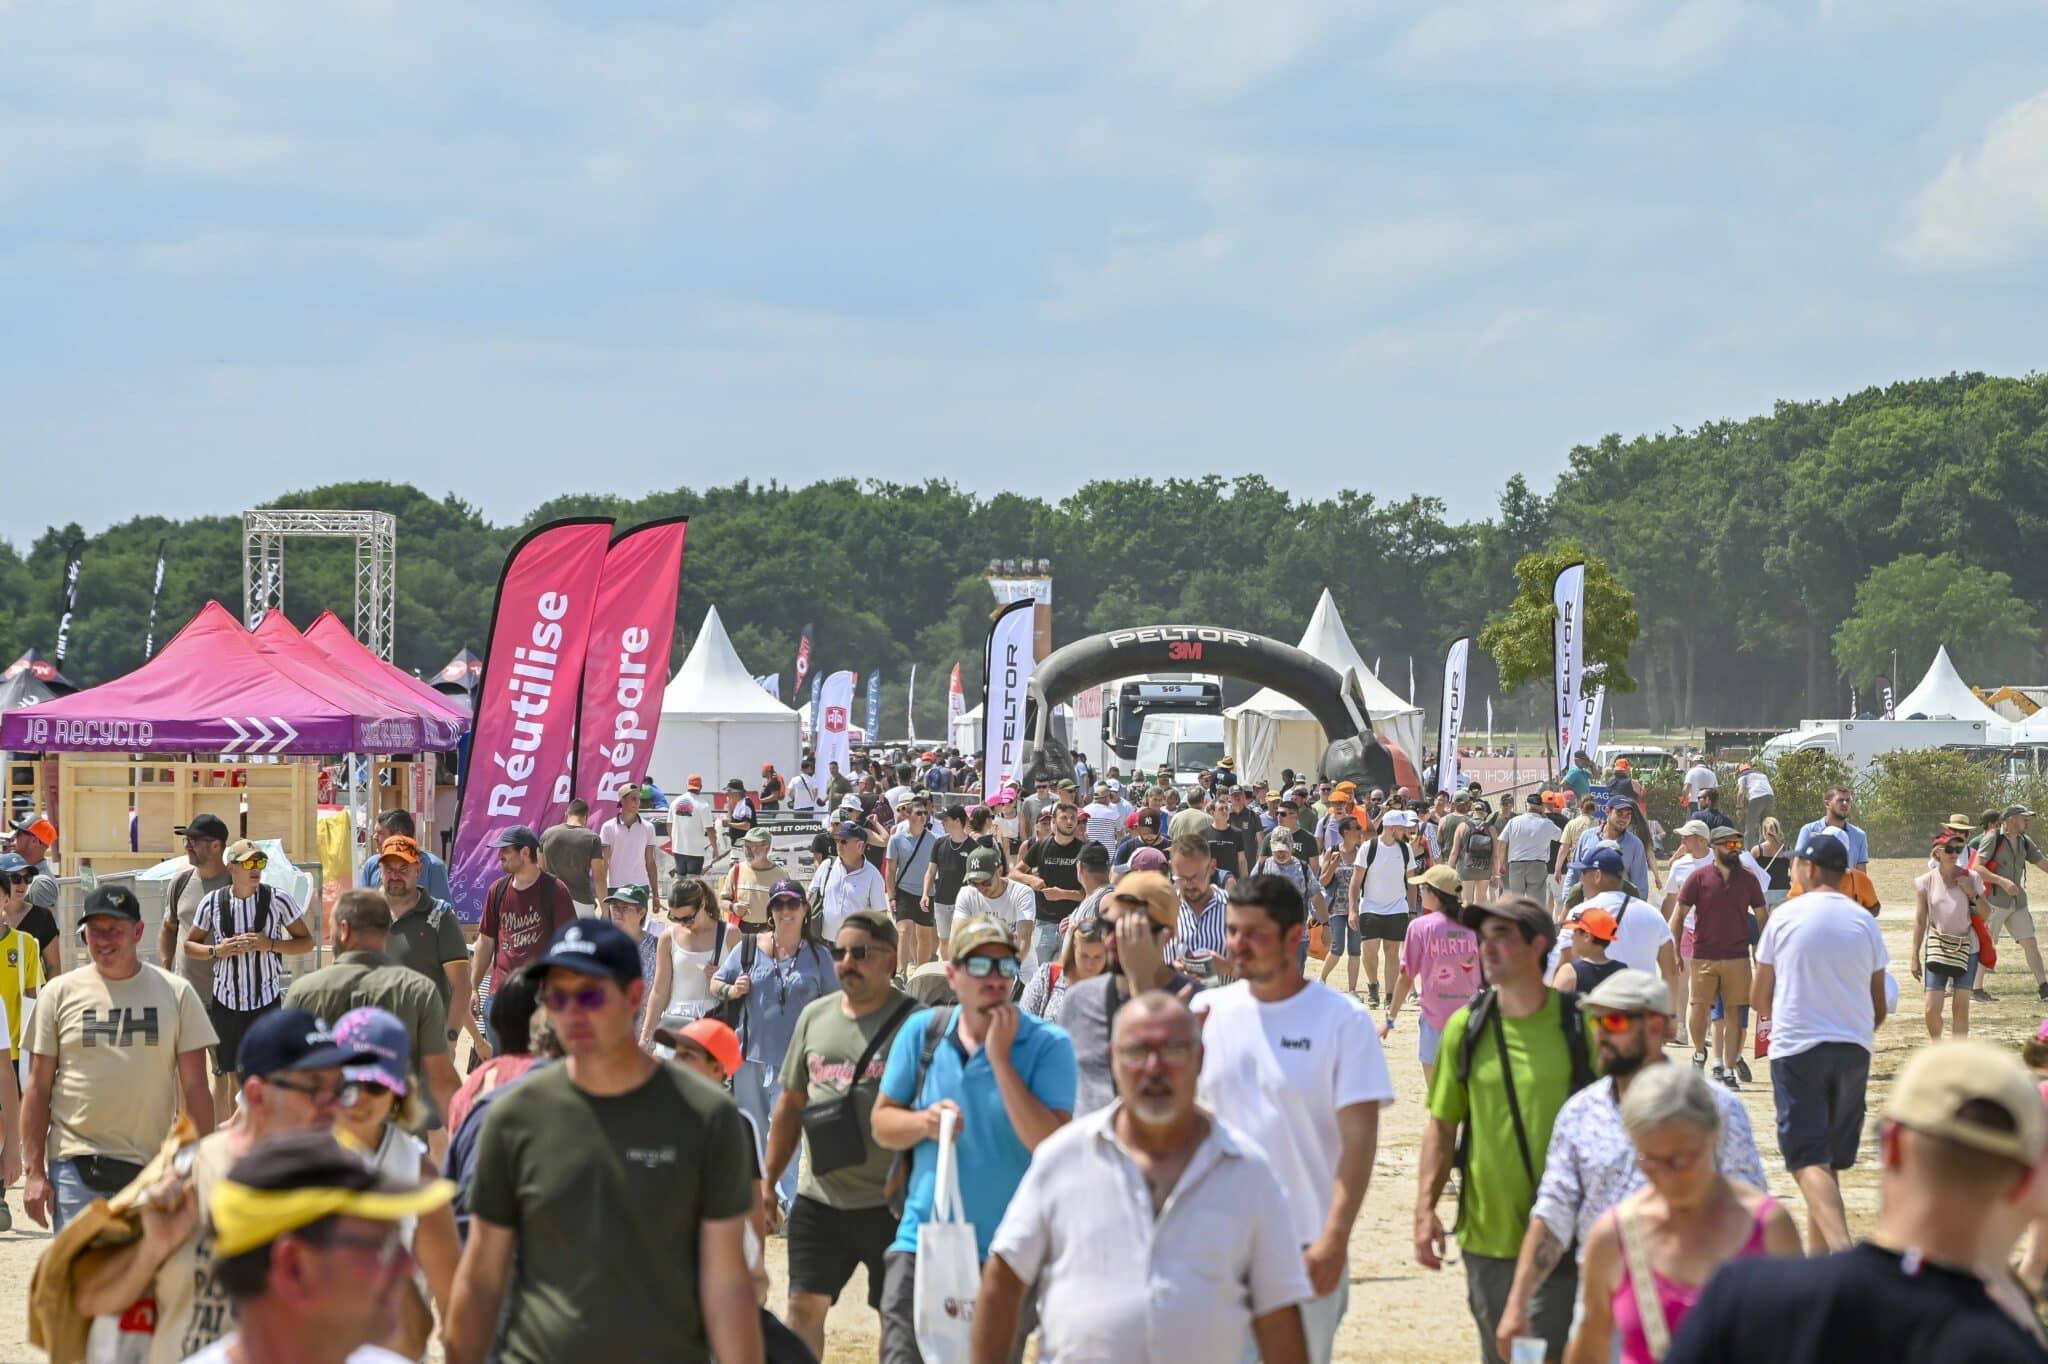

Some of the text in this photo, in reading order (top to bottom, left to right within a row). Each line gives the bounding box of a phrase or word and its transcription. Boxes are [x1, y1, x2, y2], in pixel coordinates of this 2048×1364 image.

[487, 591, 568, 816] Réutilise
[1002, 644, 1018, 765] PELTOR
[1169, 642, 1203, 660] 3M
[1562, 600, 1573, 718] PELTOR
[597, 627, 649, 800] Répare
[794, 824, 823, 832] OPTIQU
[501, 905, 541, 931] Music
